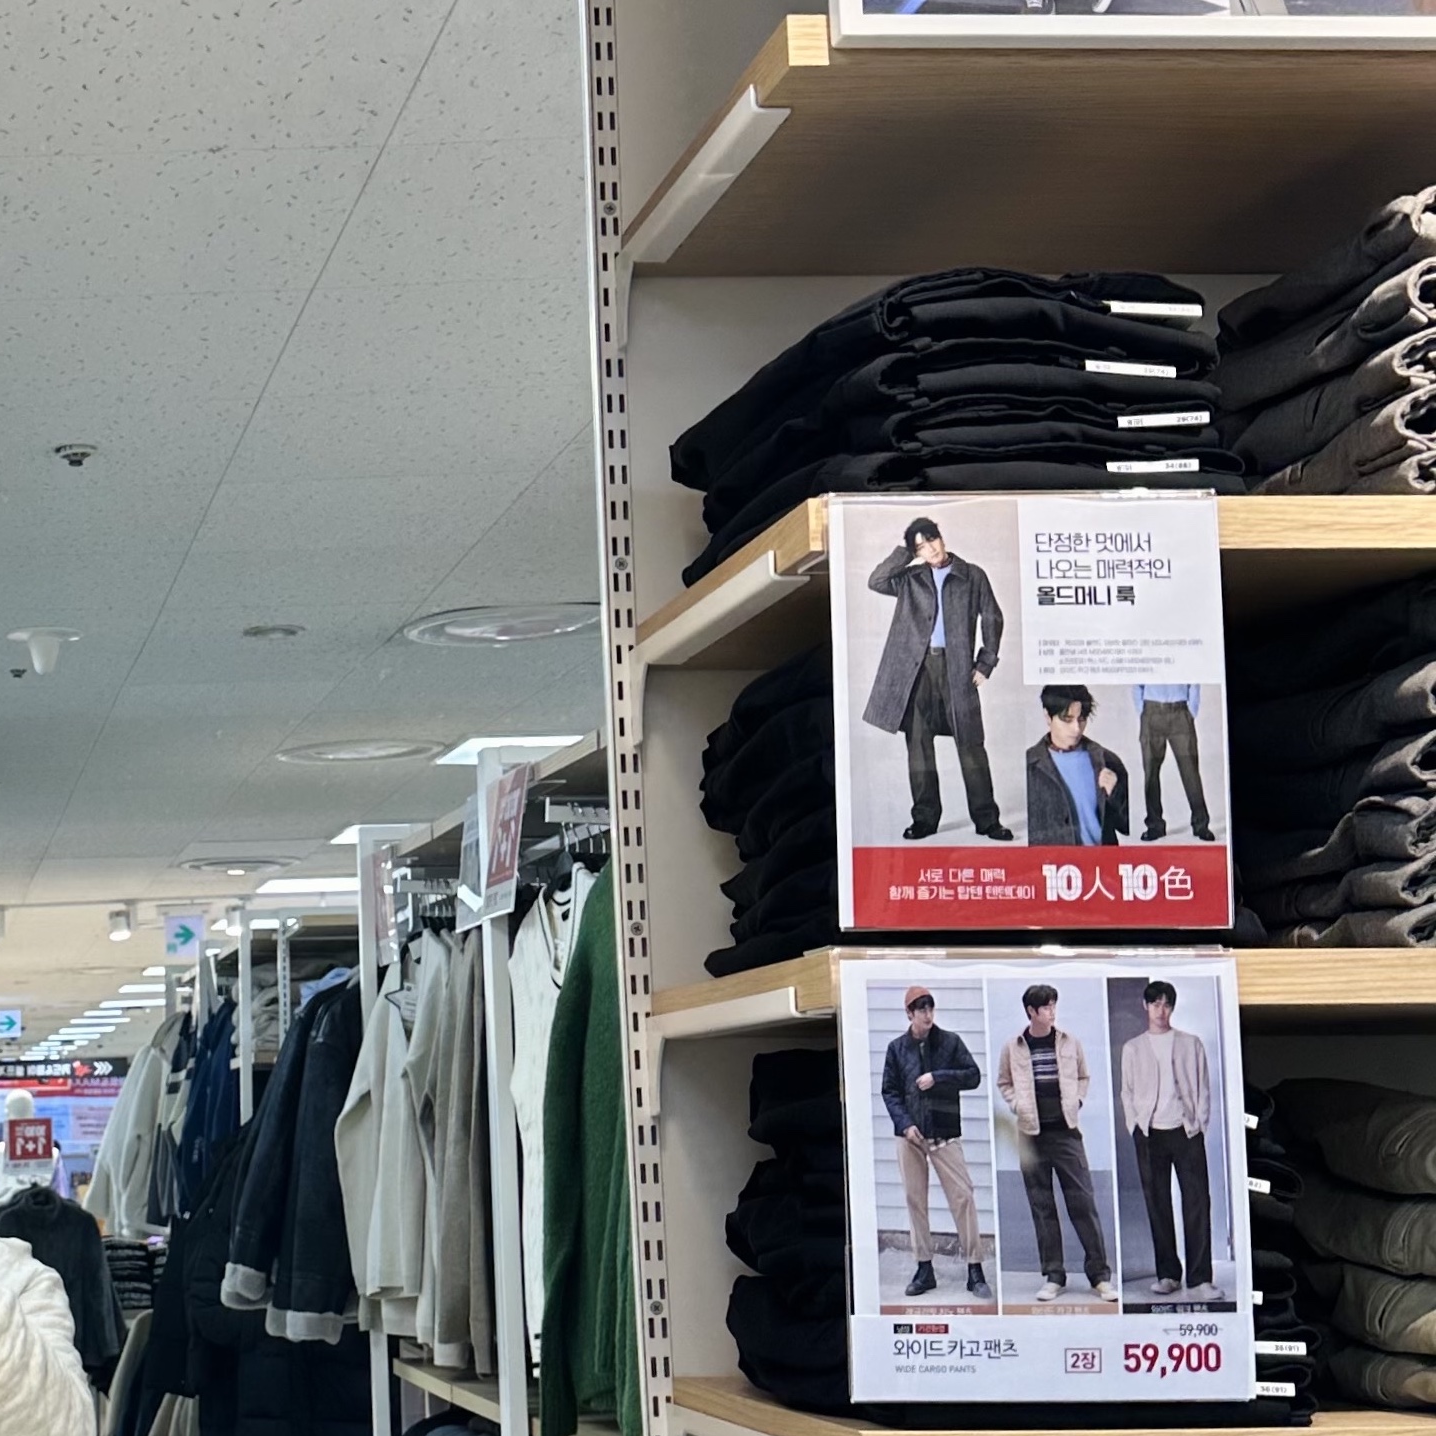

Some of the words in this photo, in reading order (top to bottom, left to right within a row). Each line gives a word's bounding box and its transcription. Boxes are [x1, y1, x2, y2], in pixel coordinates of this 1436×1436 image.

[1035, 532, 1092, 553] 단정한
[1095, 532, 1151, 553] 멋에서
[1036, 559, 1092, 579] 나오는
[1096, 558, 1171, 579] 매력적인
[1036, 585, 1112, 606] 올드머니
[1116, 585, 1135, 606] 룩
[918, 868, 944, 883] 서로
[949, 868, 975, 883] 다른
[889, 885, 914, 900] 함께
[917, 885, 954, 900] 즐기는
[957, 885, 983, 900] 탑텐
[985, 885, 1035, 900] 텐텐데이
[1179, 1323, 1218, 1338] 59,900
[893, 1339, 946, 1359] 와이드
[947, 1339, 982, 1359] 카고
[984, 1338, 1019, 1359] 팬츠
[895, 1365, 915, 1373] WIDE
[918, 1365, 947, 1373] CARGO
[949, 1365, 976, 1373] PANTS
[1070, 1352, 1096, 1369] 2장
[1123, 1343, 1222, 1379] 59,900
